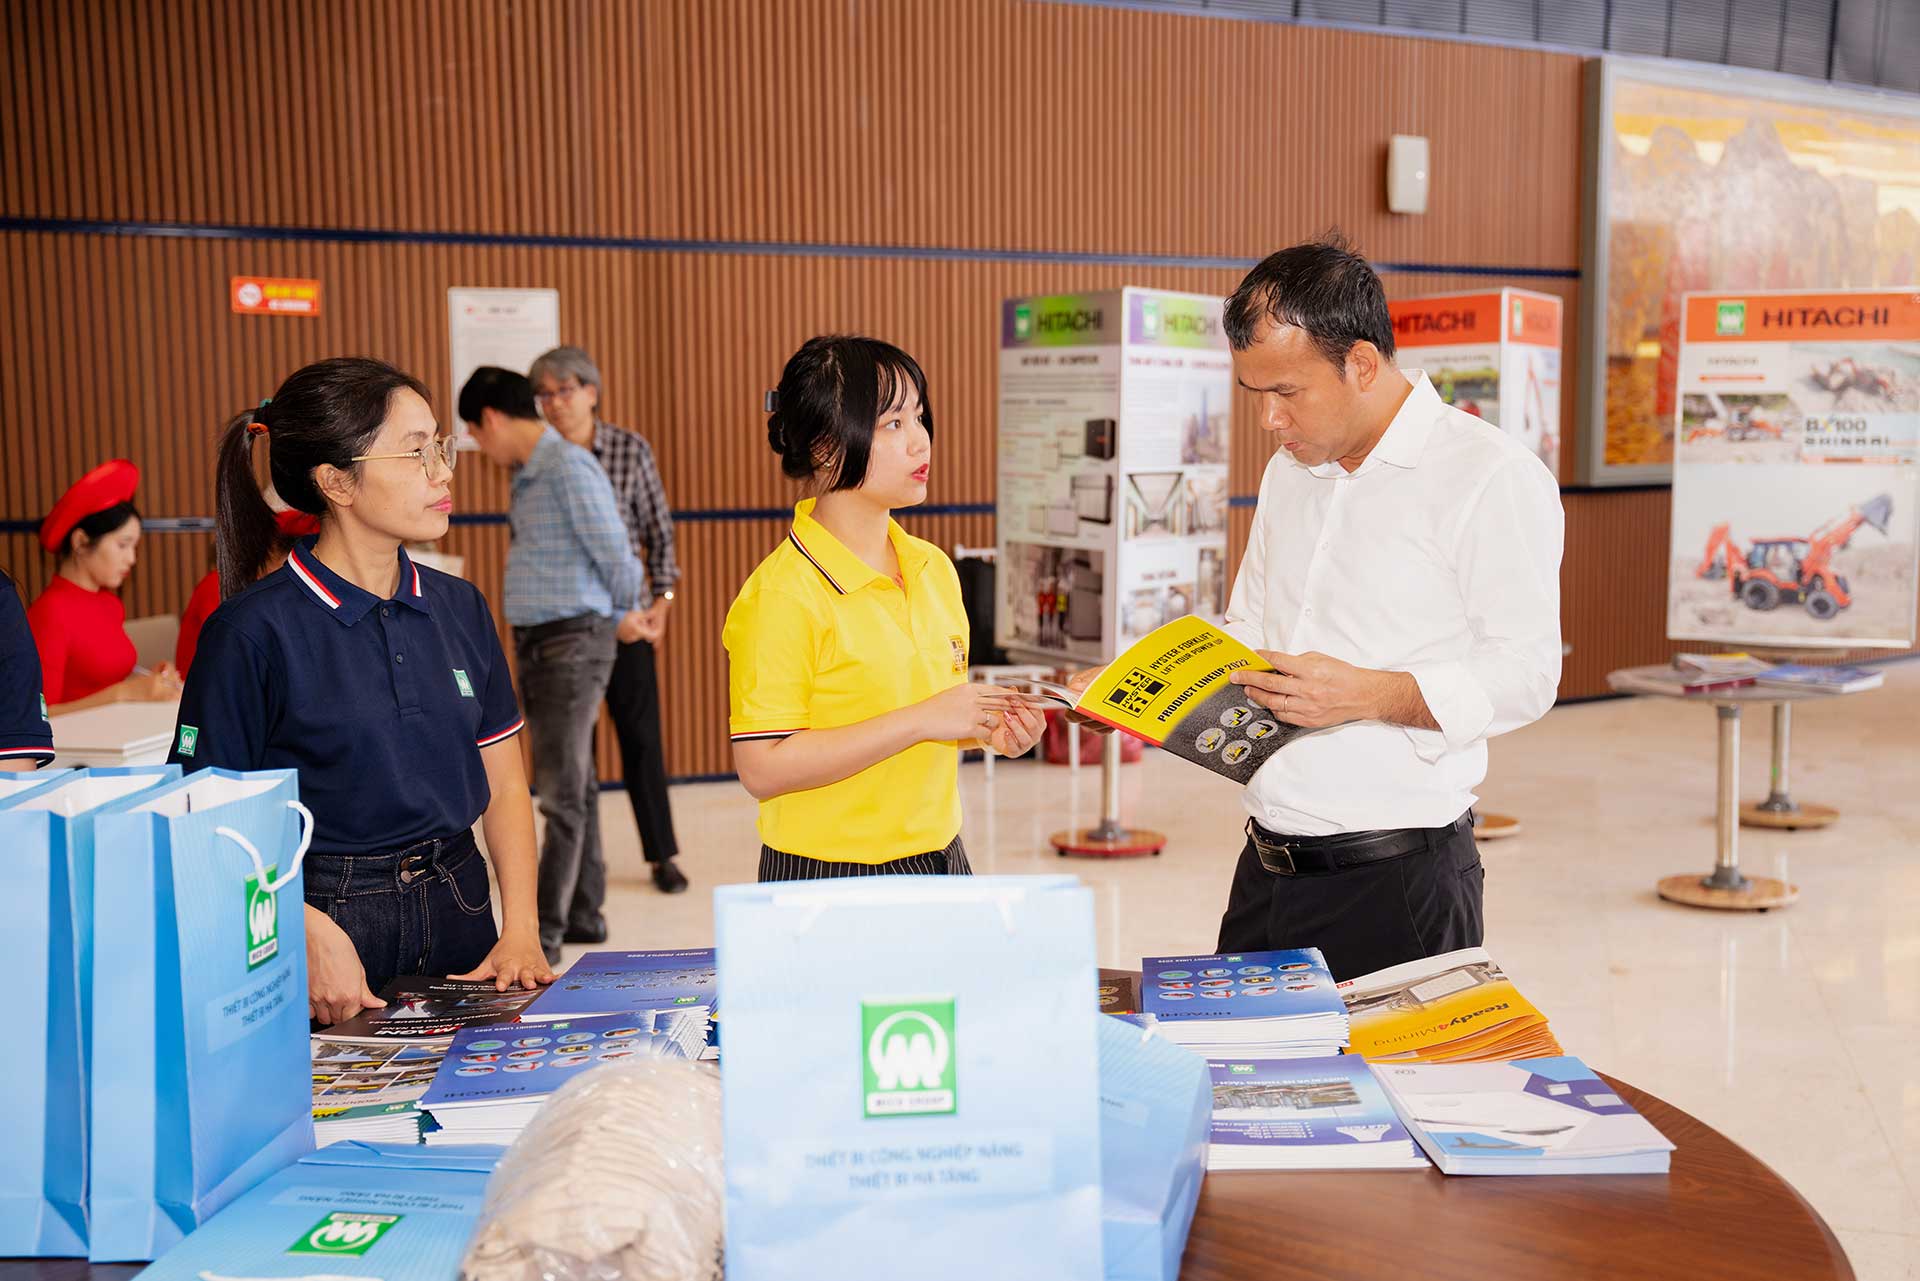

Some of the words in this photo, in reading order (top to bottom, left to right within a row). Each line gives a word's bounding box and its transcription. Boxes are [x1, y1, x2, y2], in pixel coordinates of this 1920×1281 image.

[1037, 309, 1104, 333] HITACHI
[1163, 313, 1217, 336] HITACHI
[1391, 310, 1476, 334] HITACHI
[1762, 306, 1889, 329] HITACHI
[1149, 648, 1179, 671] HYSTER
[1177, 631, 1216, 656] FORKLIFT
[1160, 663, 1176, 676] LIFT
[1174, 651, 1193, 667] YOUR
[1190, 643, 1215, 660] POWER
[1214, 638, 1224, 648] UP
[1122, 677, 1153, 708] HYSTER
[1157, 686, 1199, 722] PRODUCT
[1194, 667, 1227, 692] LINEUP
[1224, 658, 1251, 671] 2022
[374, 1025, 461, 1036] MAGNI
[443, 1087, 526, 1098] HITACHI
